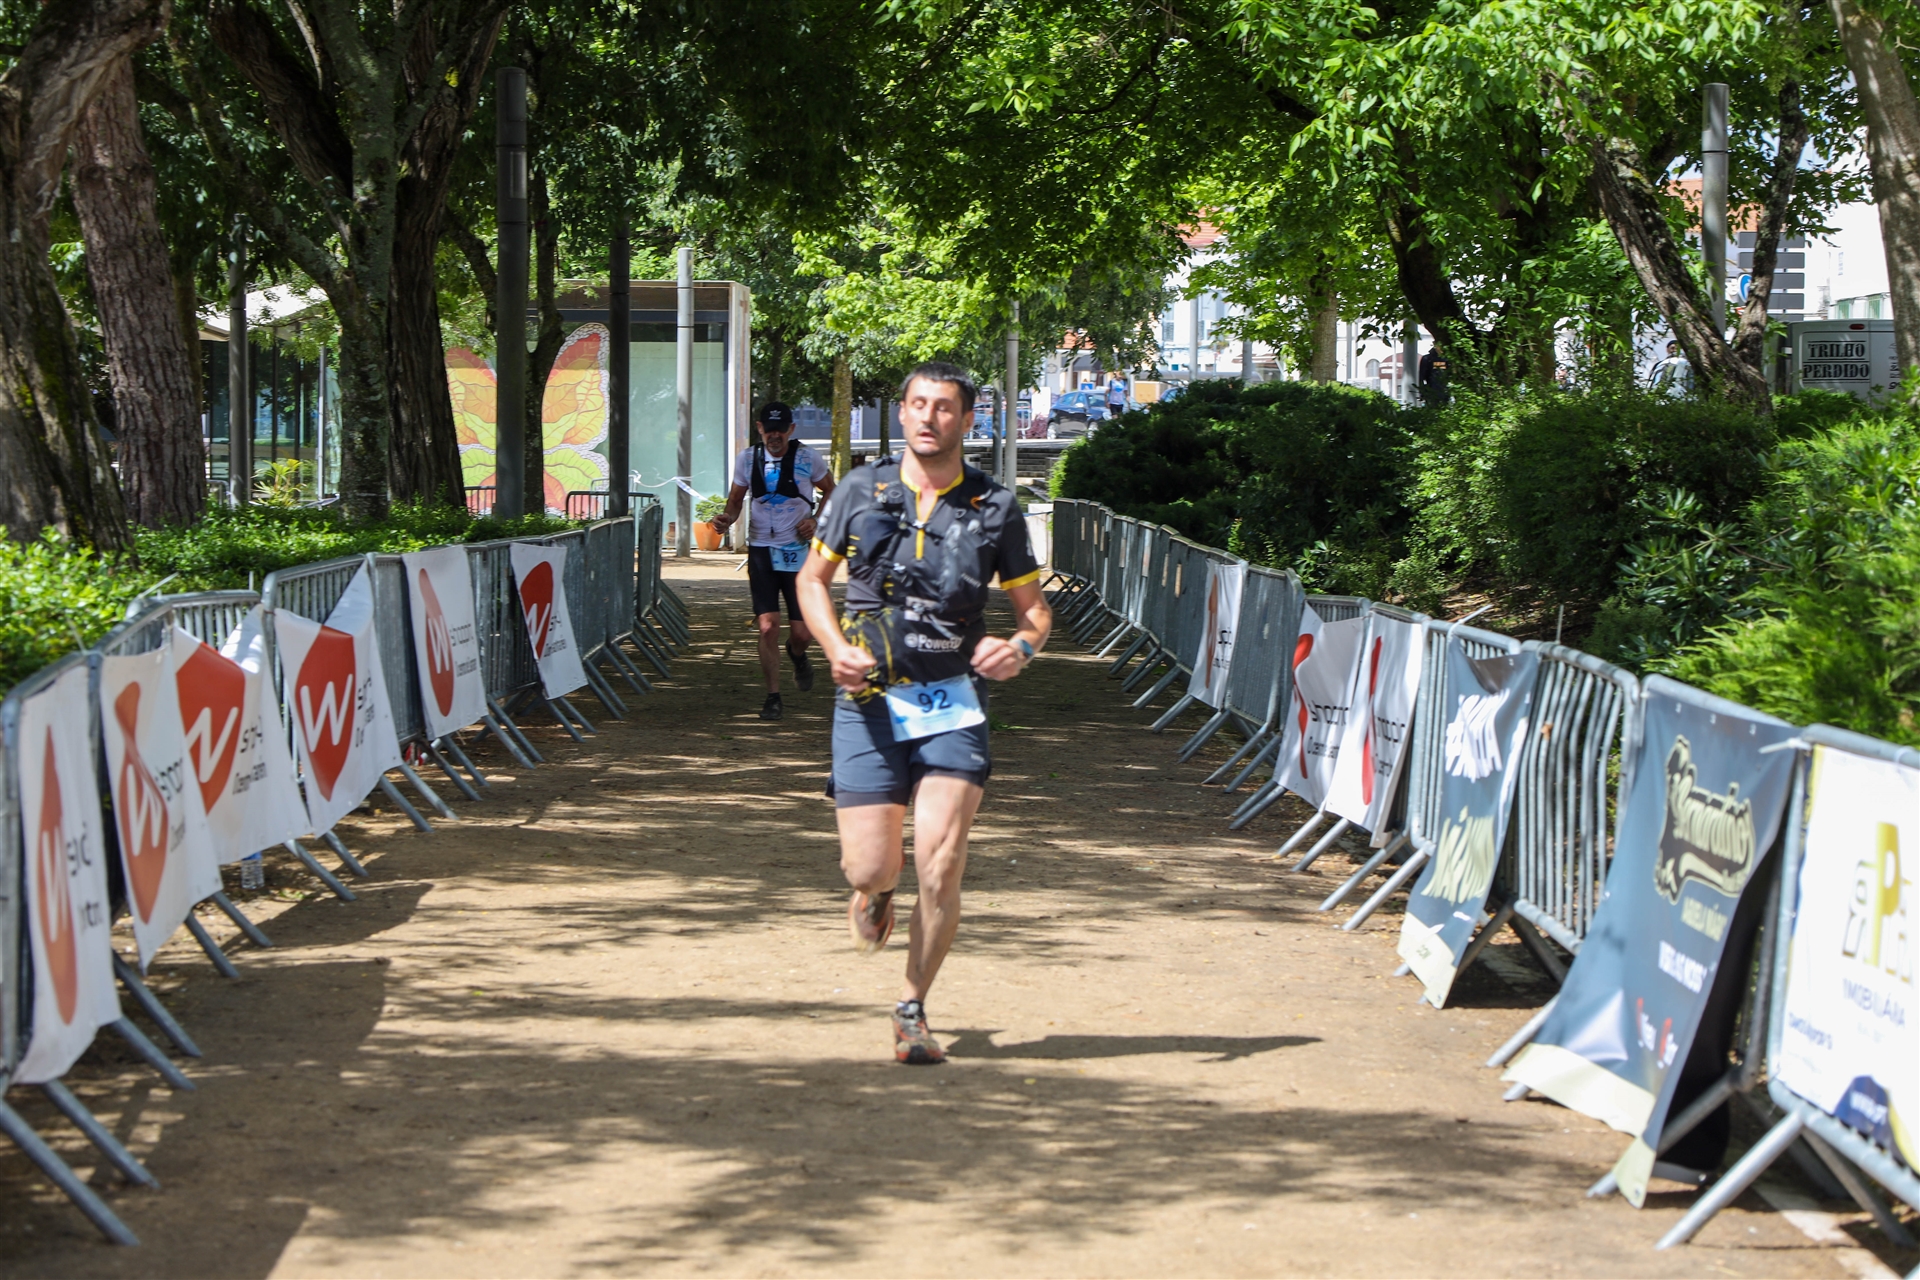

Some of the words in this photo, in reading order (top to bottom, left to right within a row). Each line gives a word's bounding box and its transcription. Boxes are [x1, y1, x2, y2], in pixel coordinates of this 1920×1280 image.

[1808, 343, 1865, 358] TRILHO
[1803, 363, 1870, 378] PERDIDO
[918, 689, 951, 713] 92
